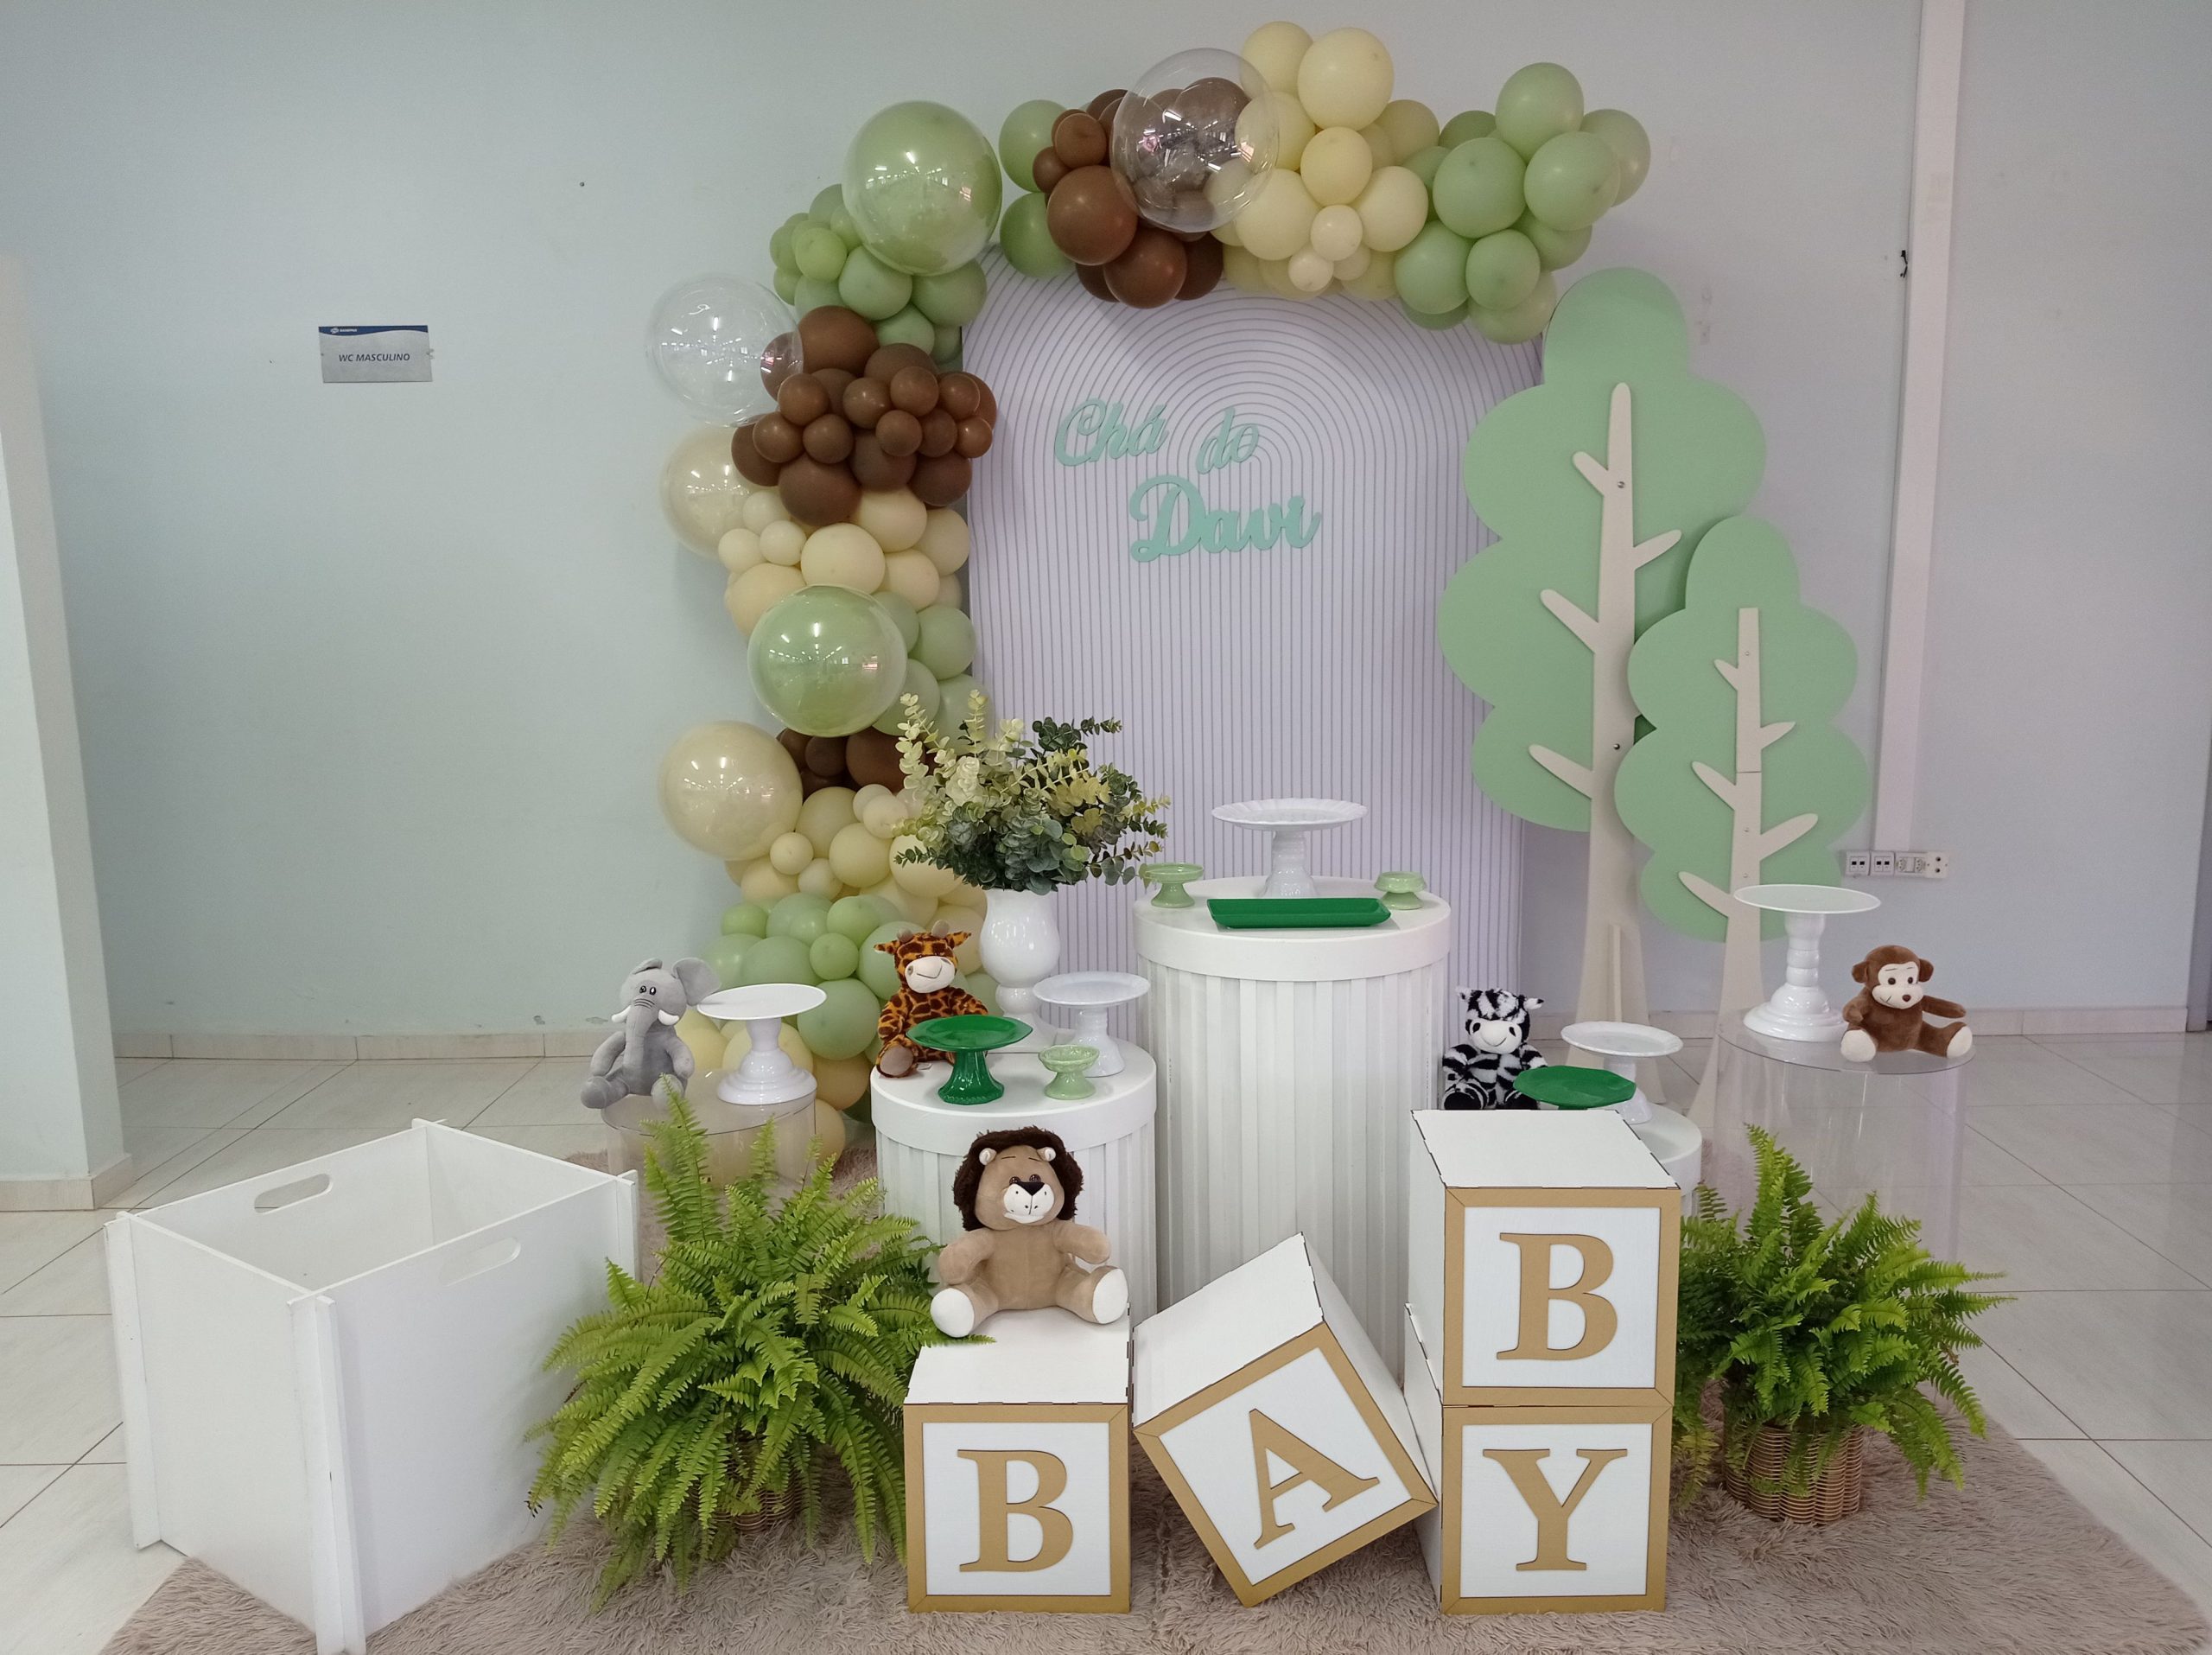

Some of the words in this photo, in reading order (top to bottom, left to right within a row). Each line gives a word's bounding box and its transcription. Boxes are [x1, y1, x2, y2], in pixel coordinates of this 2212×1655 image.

[338, 353, 353, 362] WC
[355, 353, 410, 362] MASCULINO
[1054, 398, 1168, 467] Chá
[1196, 406, 1259, 474] do
[1129, 474, 1321, 563] Davi
[1497, 1232, 1618, 1361] B
[957, 1448, 1074, 1572] B
[1249, 1408, 1380, 1550] A
[1483, 1448, 1628, 1571] Y
